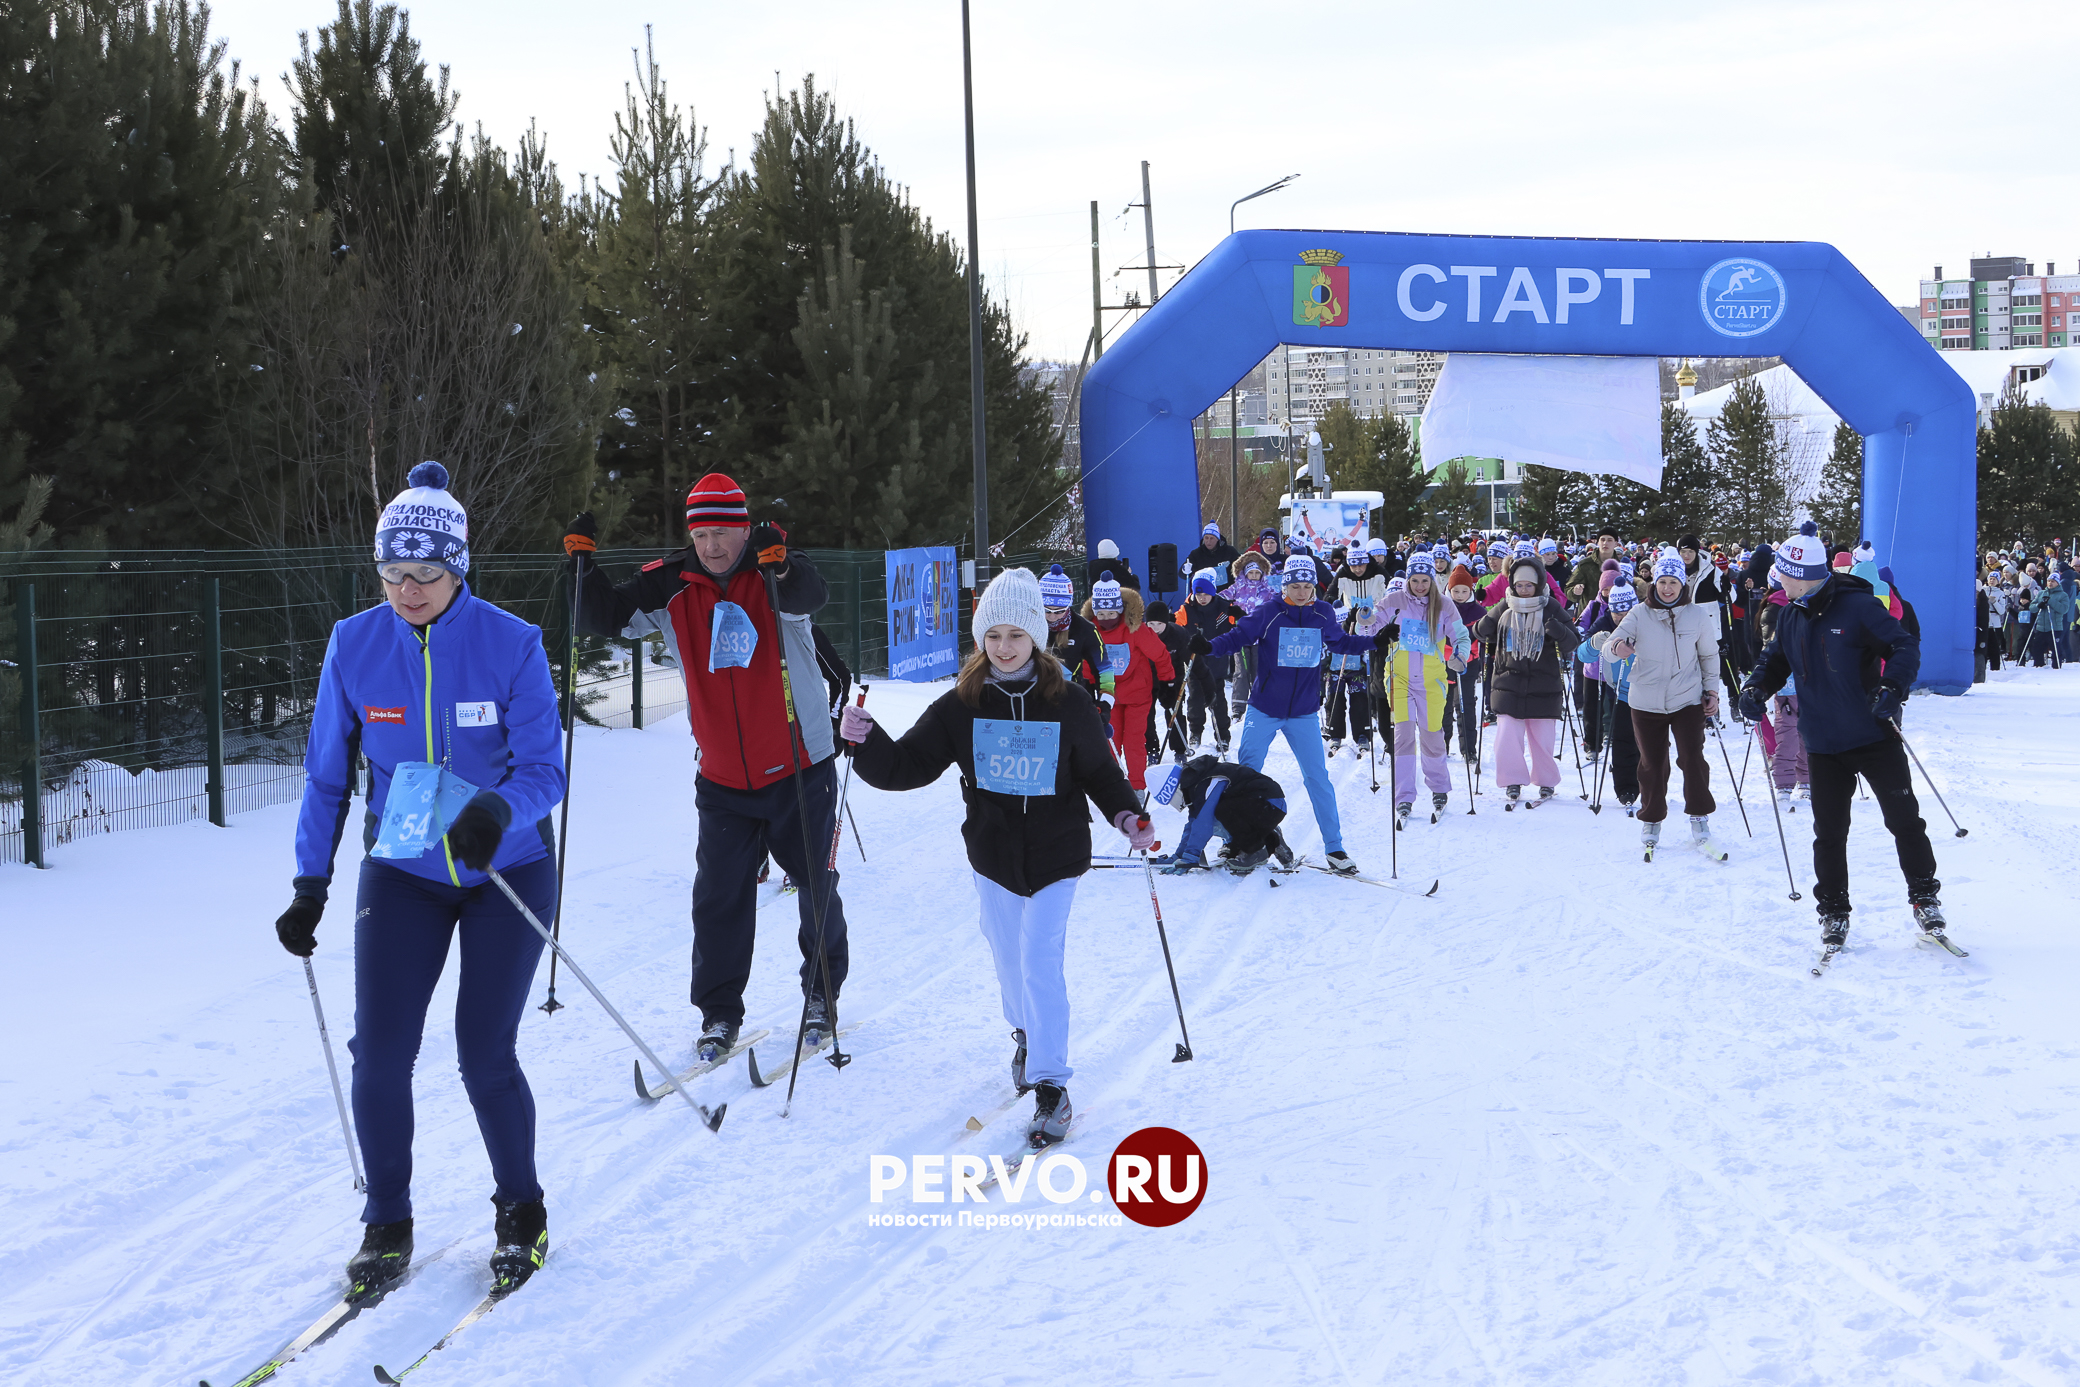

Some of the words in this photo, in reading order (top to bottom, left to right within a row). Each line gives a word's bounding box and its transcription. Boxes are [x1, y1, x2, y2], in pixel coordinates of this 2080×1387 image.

[1396, 263, 1651, 325] СТАРТ
[1714, 305, 1772, 319] СТАРТ
[382, 515, 452, 533] ОБЛАСТЬ
[1407, 634, 1431, 648] 5203
[1286, 645, 1314, 659] 5047
[370, 710, 387, 719] Альфа
[387, 711, 402, 719] Банк
[1009, 742, 1036, 750] РОССИИ
[1010, 736, 1037, 744] ЛЫЖНЯ
[989, 754, 1045, 781] 5207
[1157, 776, 1179, 805] 2026
